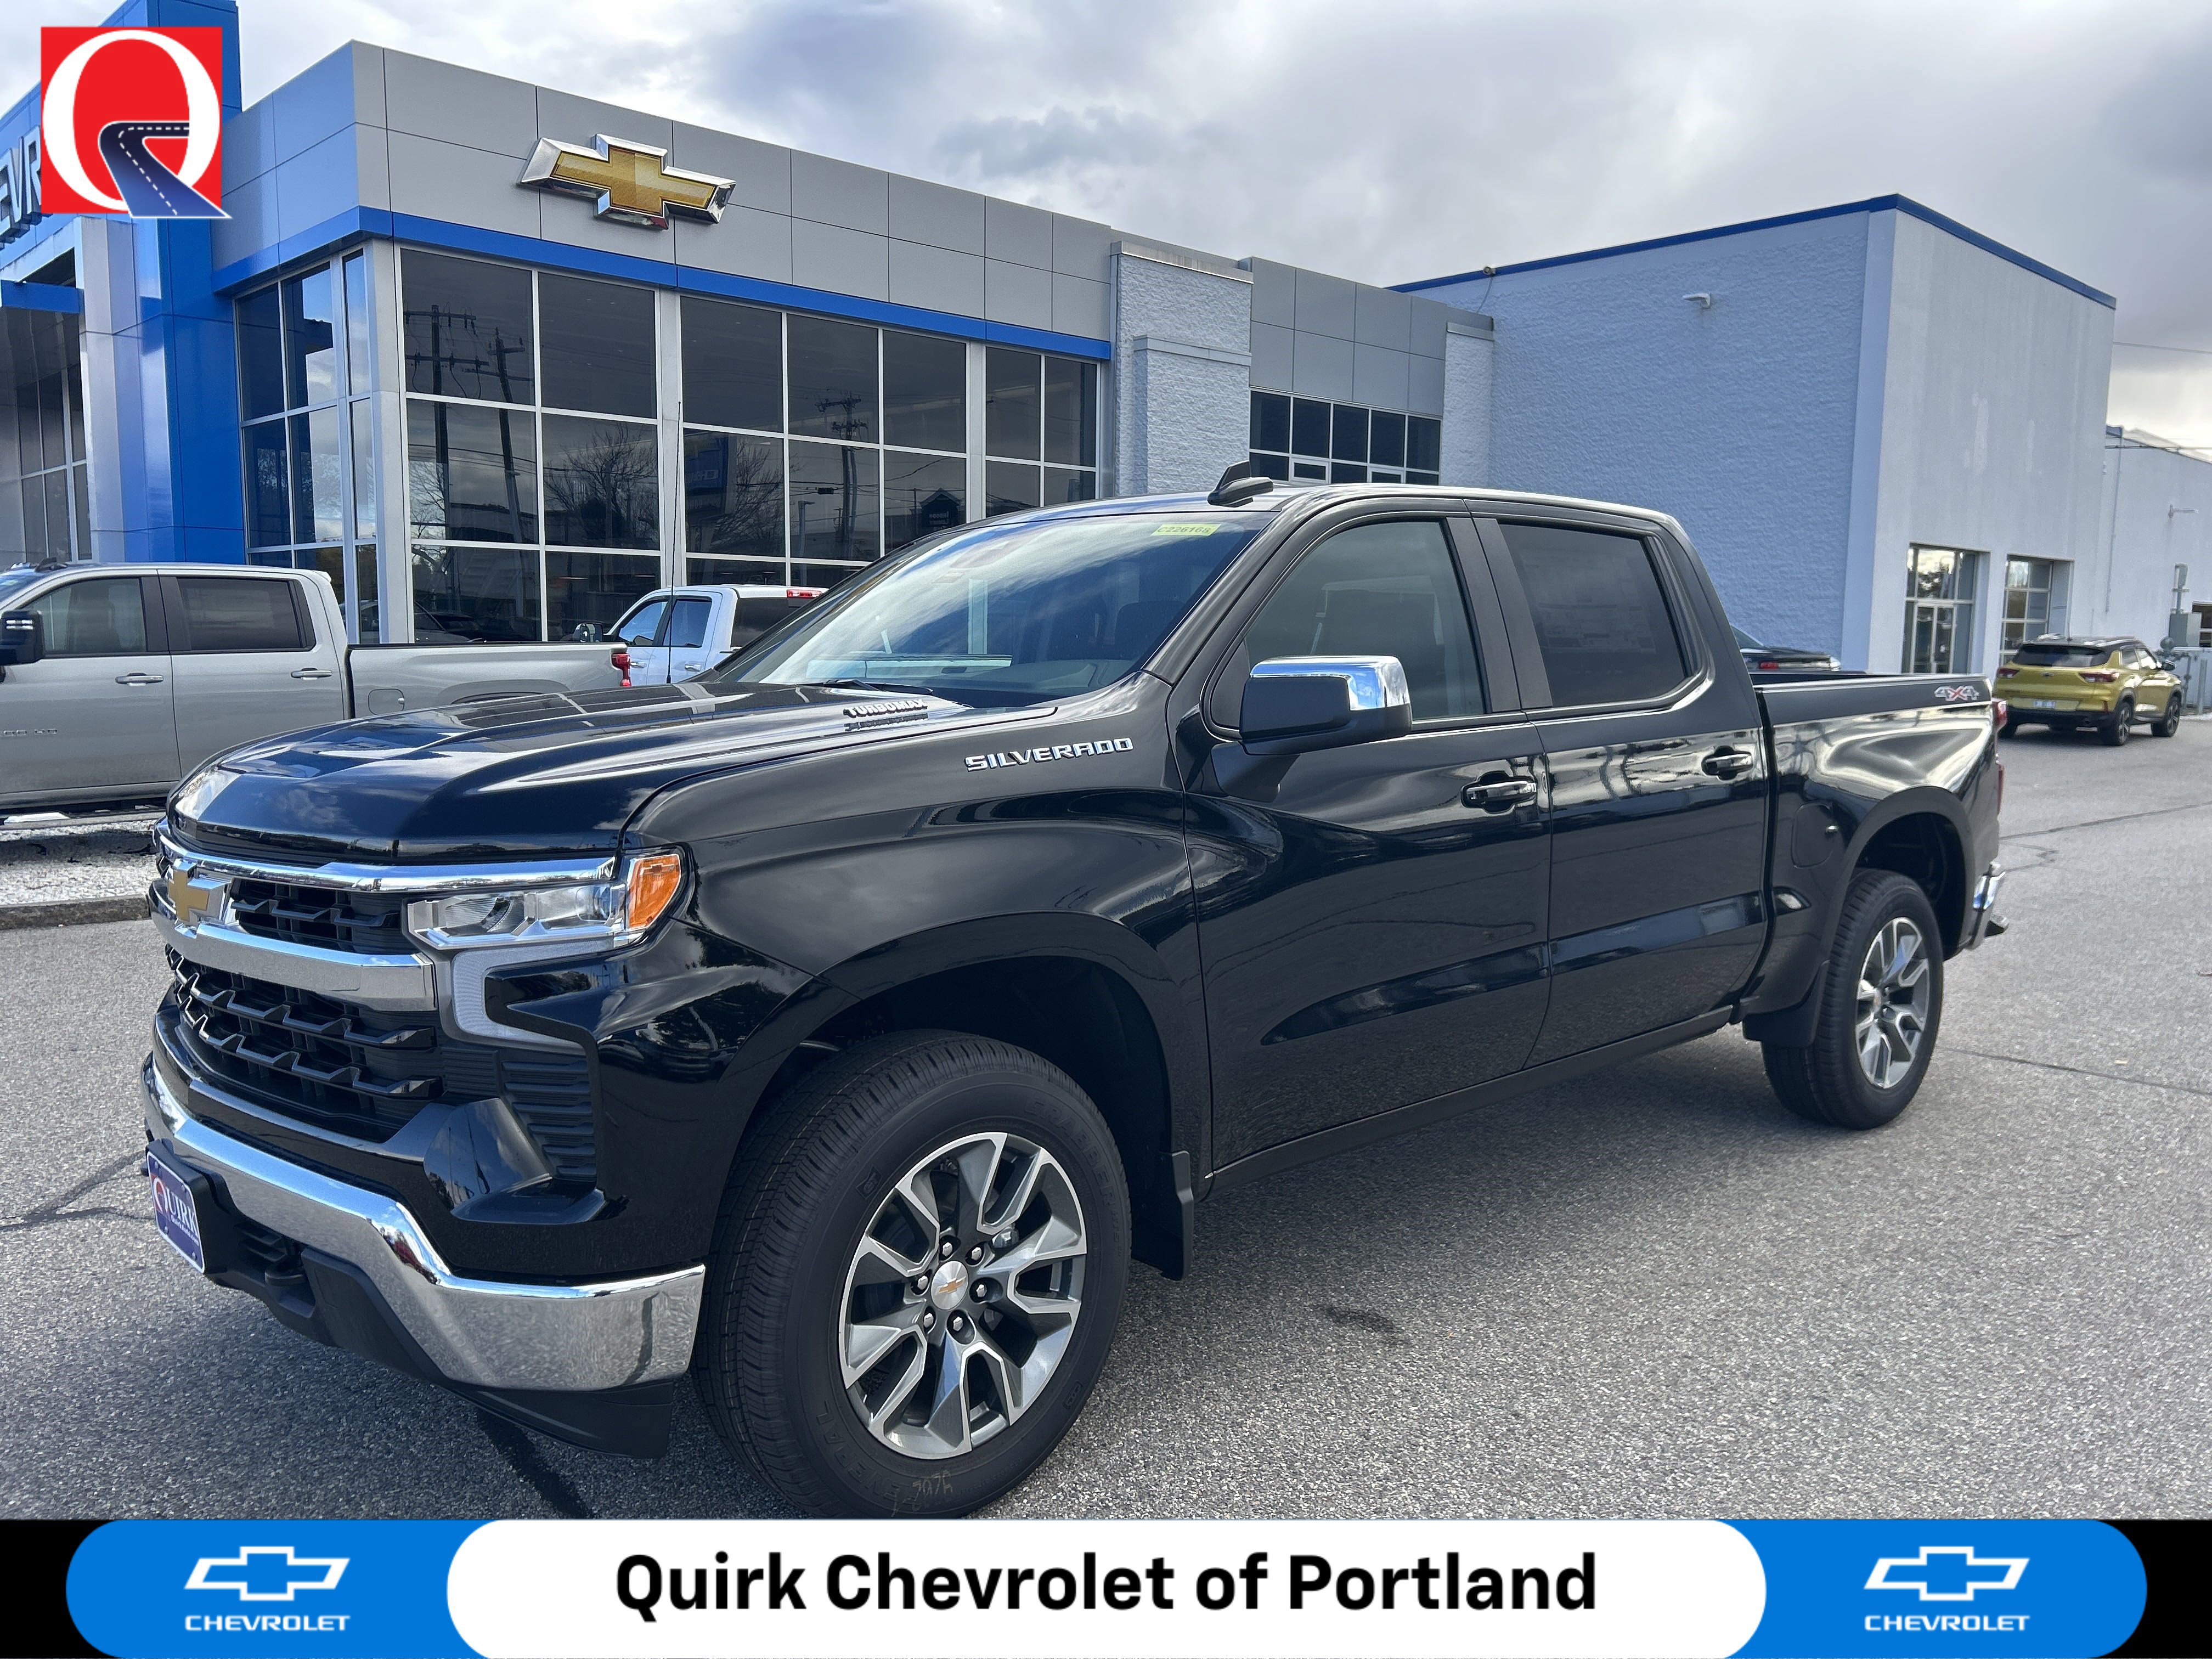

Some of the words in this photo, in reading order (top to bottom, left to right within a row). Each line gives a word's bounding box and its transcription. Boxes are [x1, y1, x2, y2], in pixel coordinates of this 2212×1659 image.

[843, 698, 928, 718] TURBOMAX
[965, 737, 1134, 772] SILVERADO
[153, 1177, 200, 1239] QUIRK
